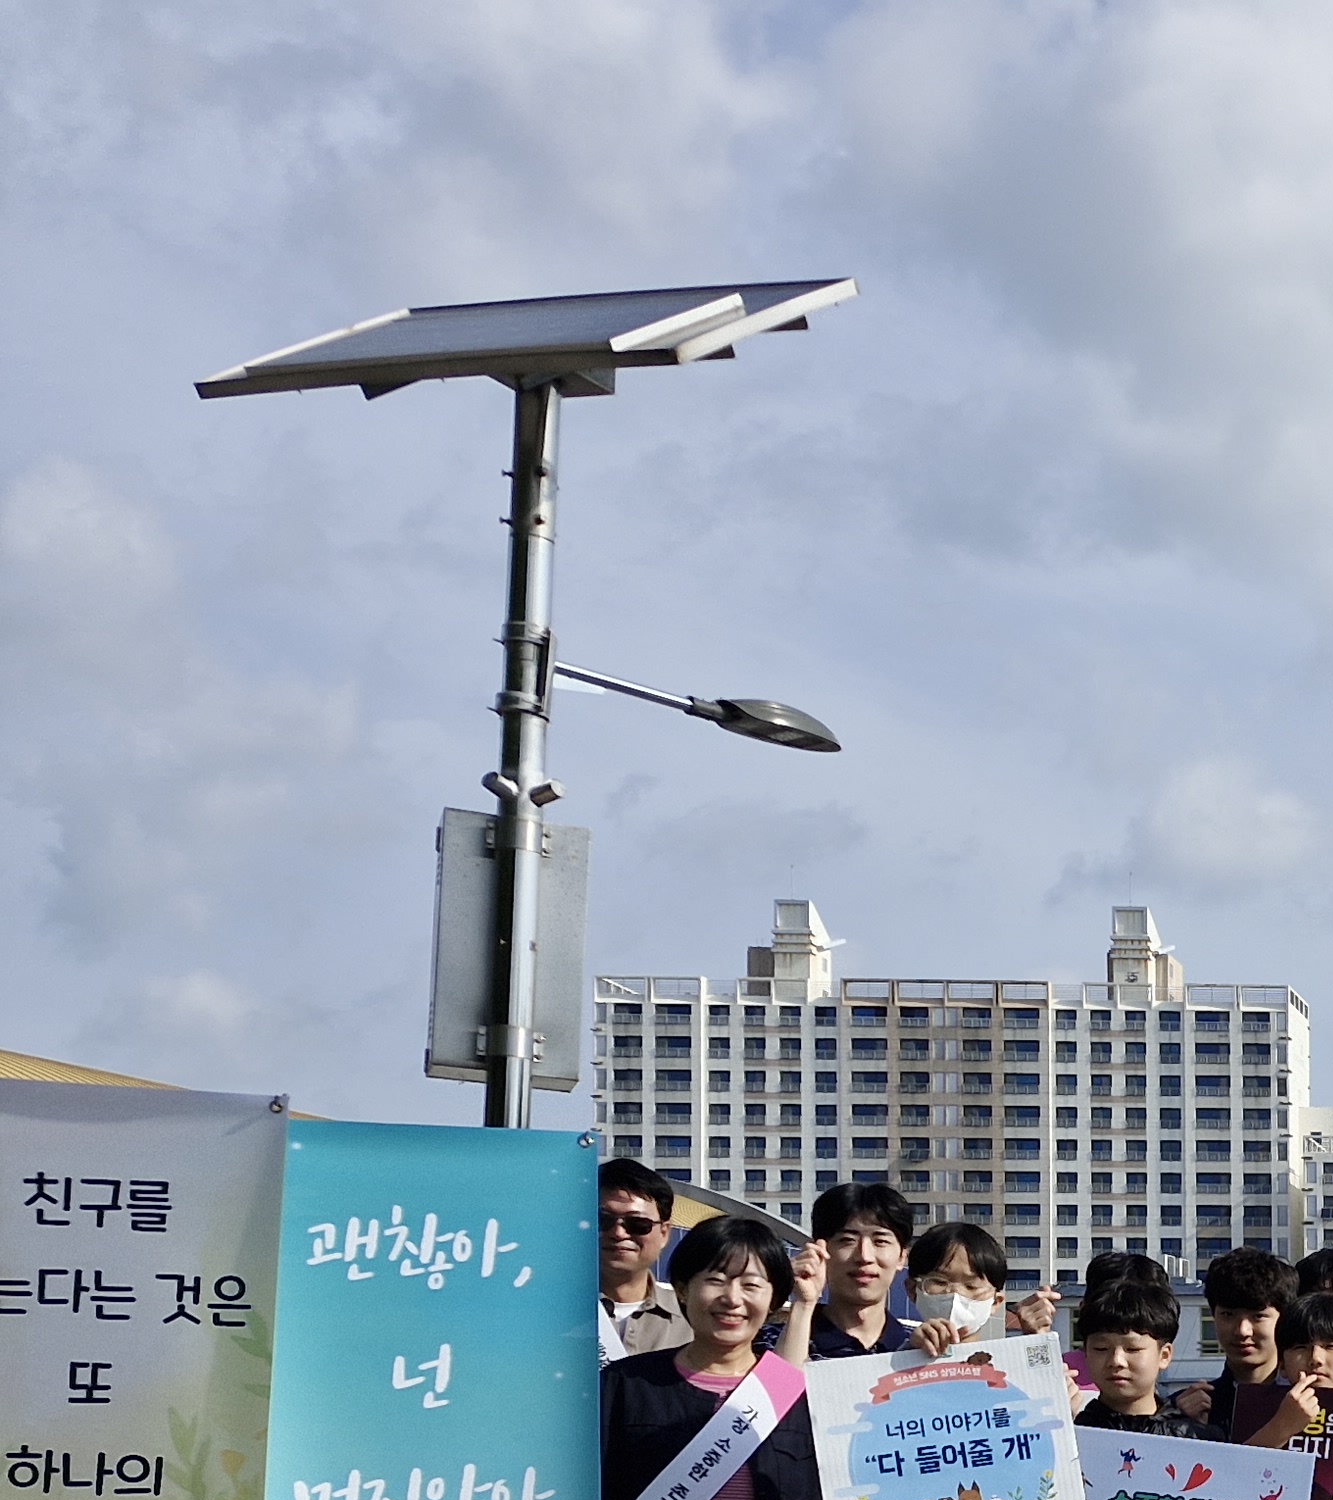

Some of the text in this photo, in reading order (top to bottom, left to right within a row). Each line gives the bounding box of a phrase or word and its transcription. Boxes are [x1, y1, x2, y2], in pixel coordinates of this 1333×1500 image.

[23, 1171, 173, 1233] 친구를
[305, 1202, 533, 1290] 괜찮아,
[155, 1273, 252, 1327] 것은
[67, 1361, 113, 1404] 또
[392, 1342, 452, 1410] 넌
[731, 1404, 759, 1436] 가장
[885, 1407, 1012, 1440] 너의 이야기를
[5, 1444, 164, 1497] 하나의
[688, 1437, 732, 1483] 소중한
[864, 1433, 1041, 1478] “다 들어줄 개”
